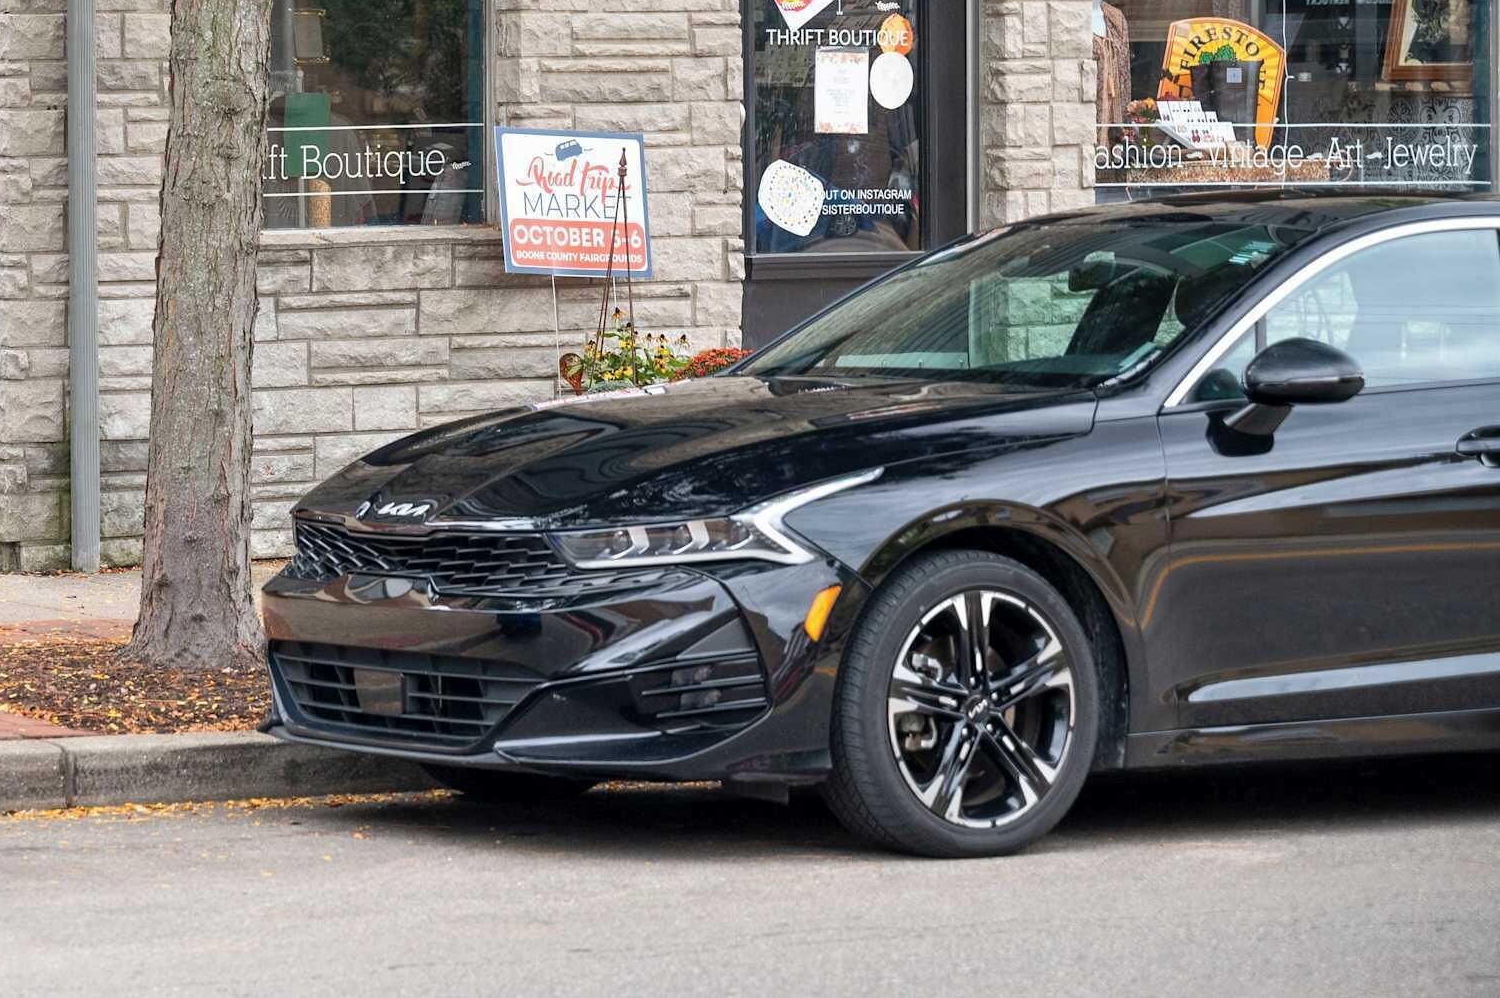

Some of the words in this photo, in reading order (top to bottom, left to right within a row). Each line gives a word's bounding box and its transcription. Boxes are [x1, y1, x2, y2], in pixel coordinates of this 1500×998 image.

[765, 28, 825, 46] THRIFT
[828, 28, 909, 46] BOUTIQUE
[300, 144, 445, 185] Boutique
[1094, 136, 1184, 169] ashion
[1325, 136, 1364, 170] Art
[1384, 136, 1478, 175] Jewelry
[516, 156, 577, 194] Road
[523, 192, 632, 220] MARKET
[840, 189, 855, 200] ON
[857, 189, 912, 200] INSTAGRAM
[822, 203, 905, 215] SISTERBOUTIQUE
[513, 224, 606, 248] OCTOBER
[516, 250, 545, 261] BOONE
[546, 251, 578, 262] COUNTY
